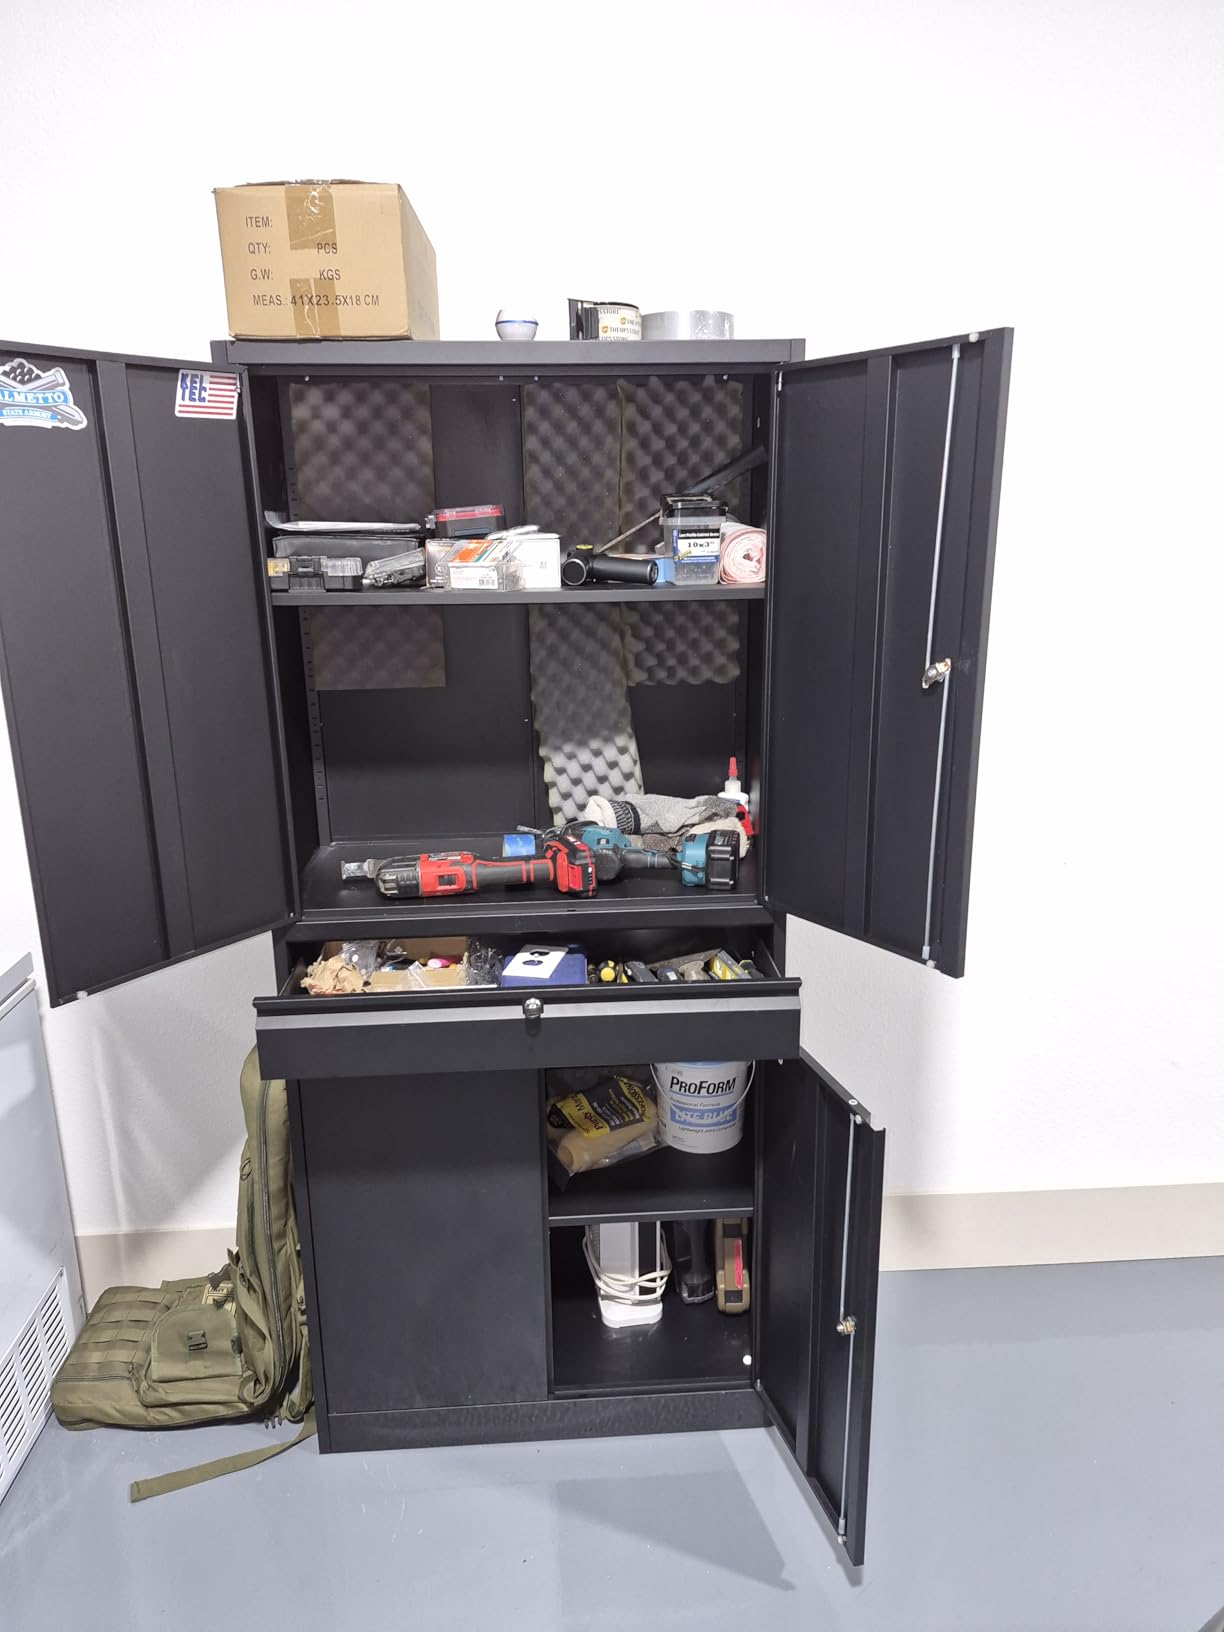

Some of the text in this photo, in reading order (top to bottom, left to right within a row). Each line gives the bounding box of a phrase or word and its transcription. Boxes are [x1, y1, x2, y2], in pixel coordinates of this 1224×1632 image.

[245, 216, 273, 228] ITEM:
[248, 242, 338, 255] QTY: PCS
[250, 269, 341, 280] G.W: KGS
[363, 295, 380, 306] CM
